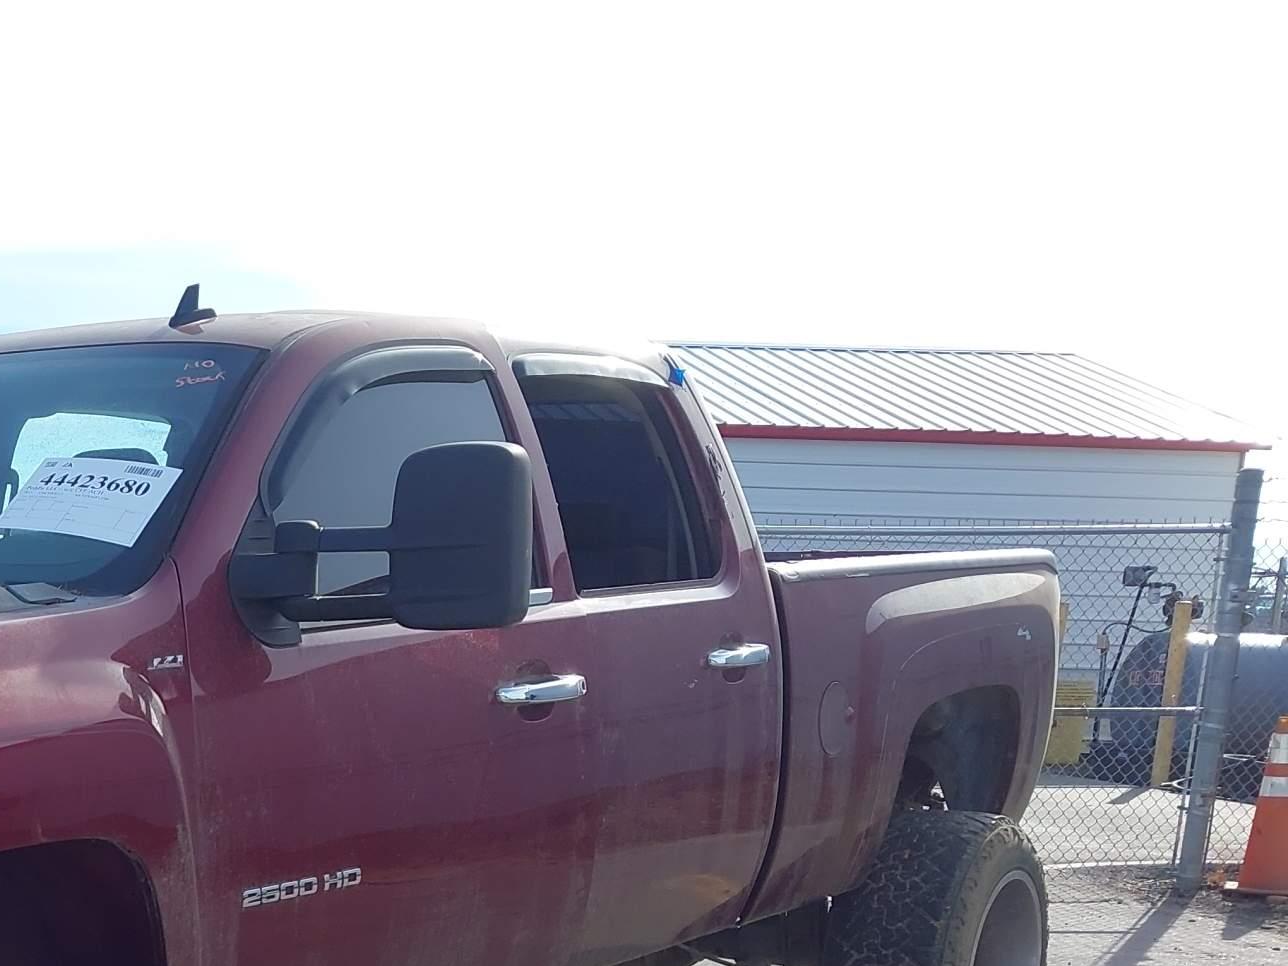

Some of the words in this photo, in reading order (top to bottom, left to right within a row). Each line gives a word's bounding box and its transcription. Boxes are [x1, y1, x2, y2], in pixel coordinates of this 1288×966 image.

[39, 472, 151, 496] 44423680
[242, 876, 318, 908] 2500
[323, 867, 362, 891] HD
